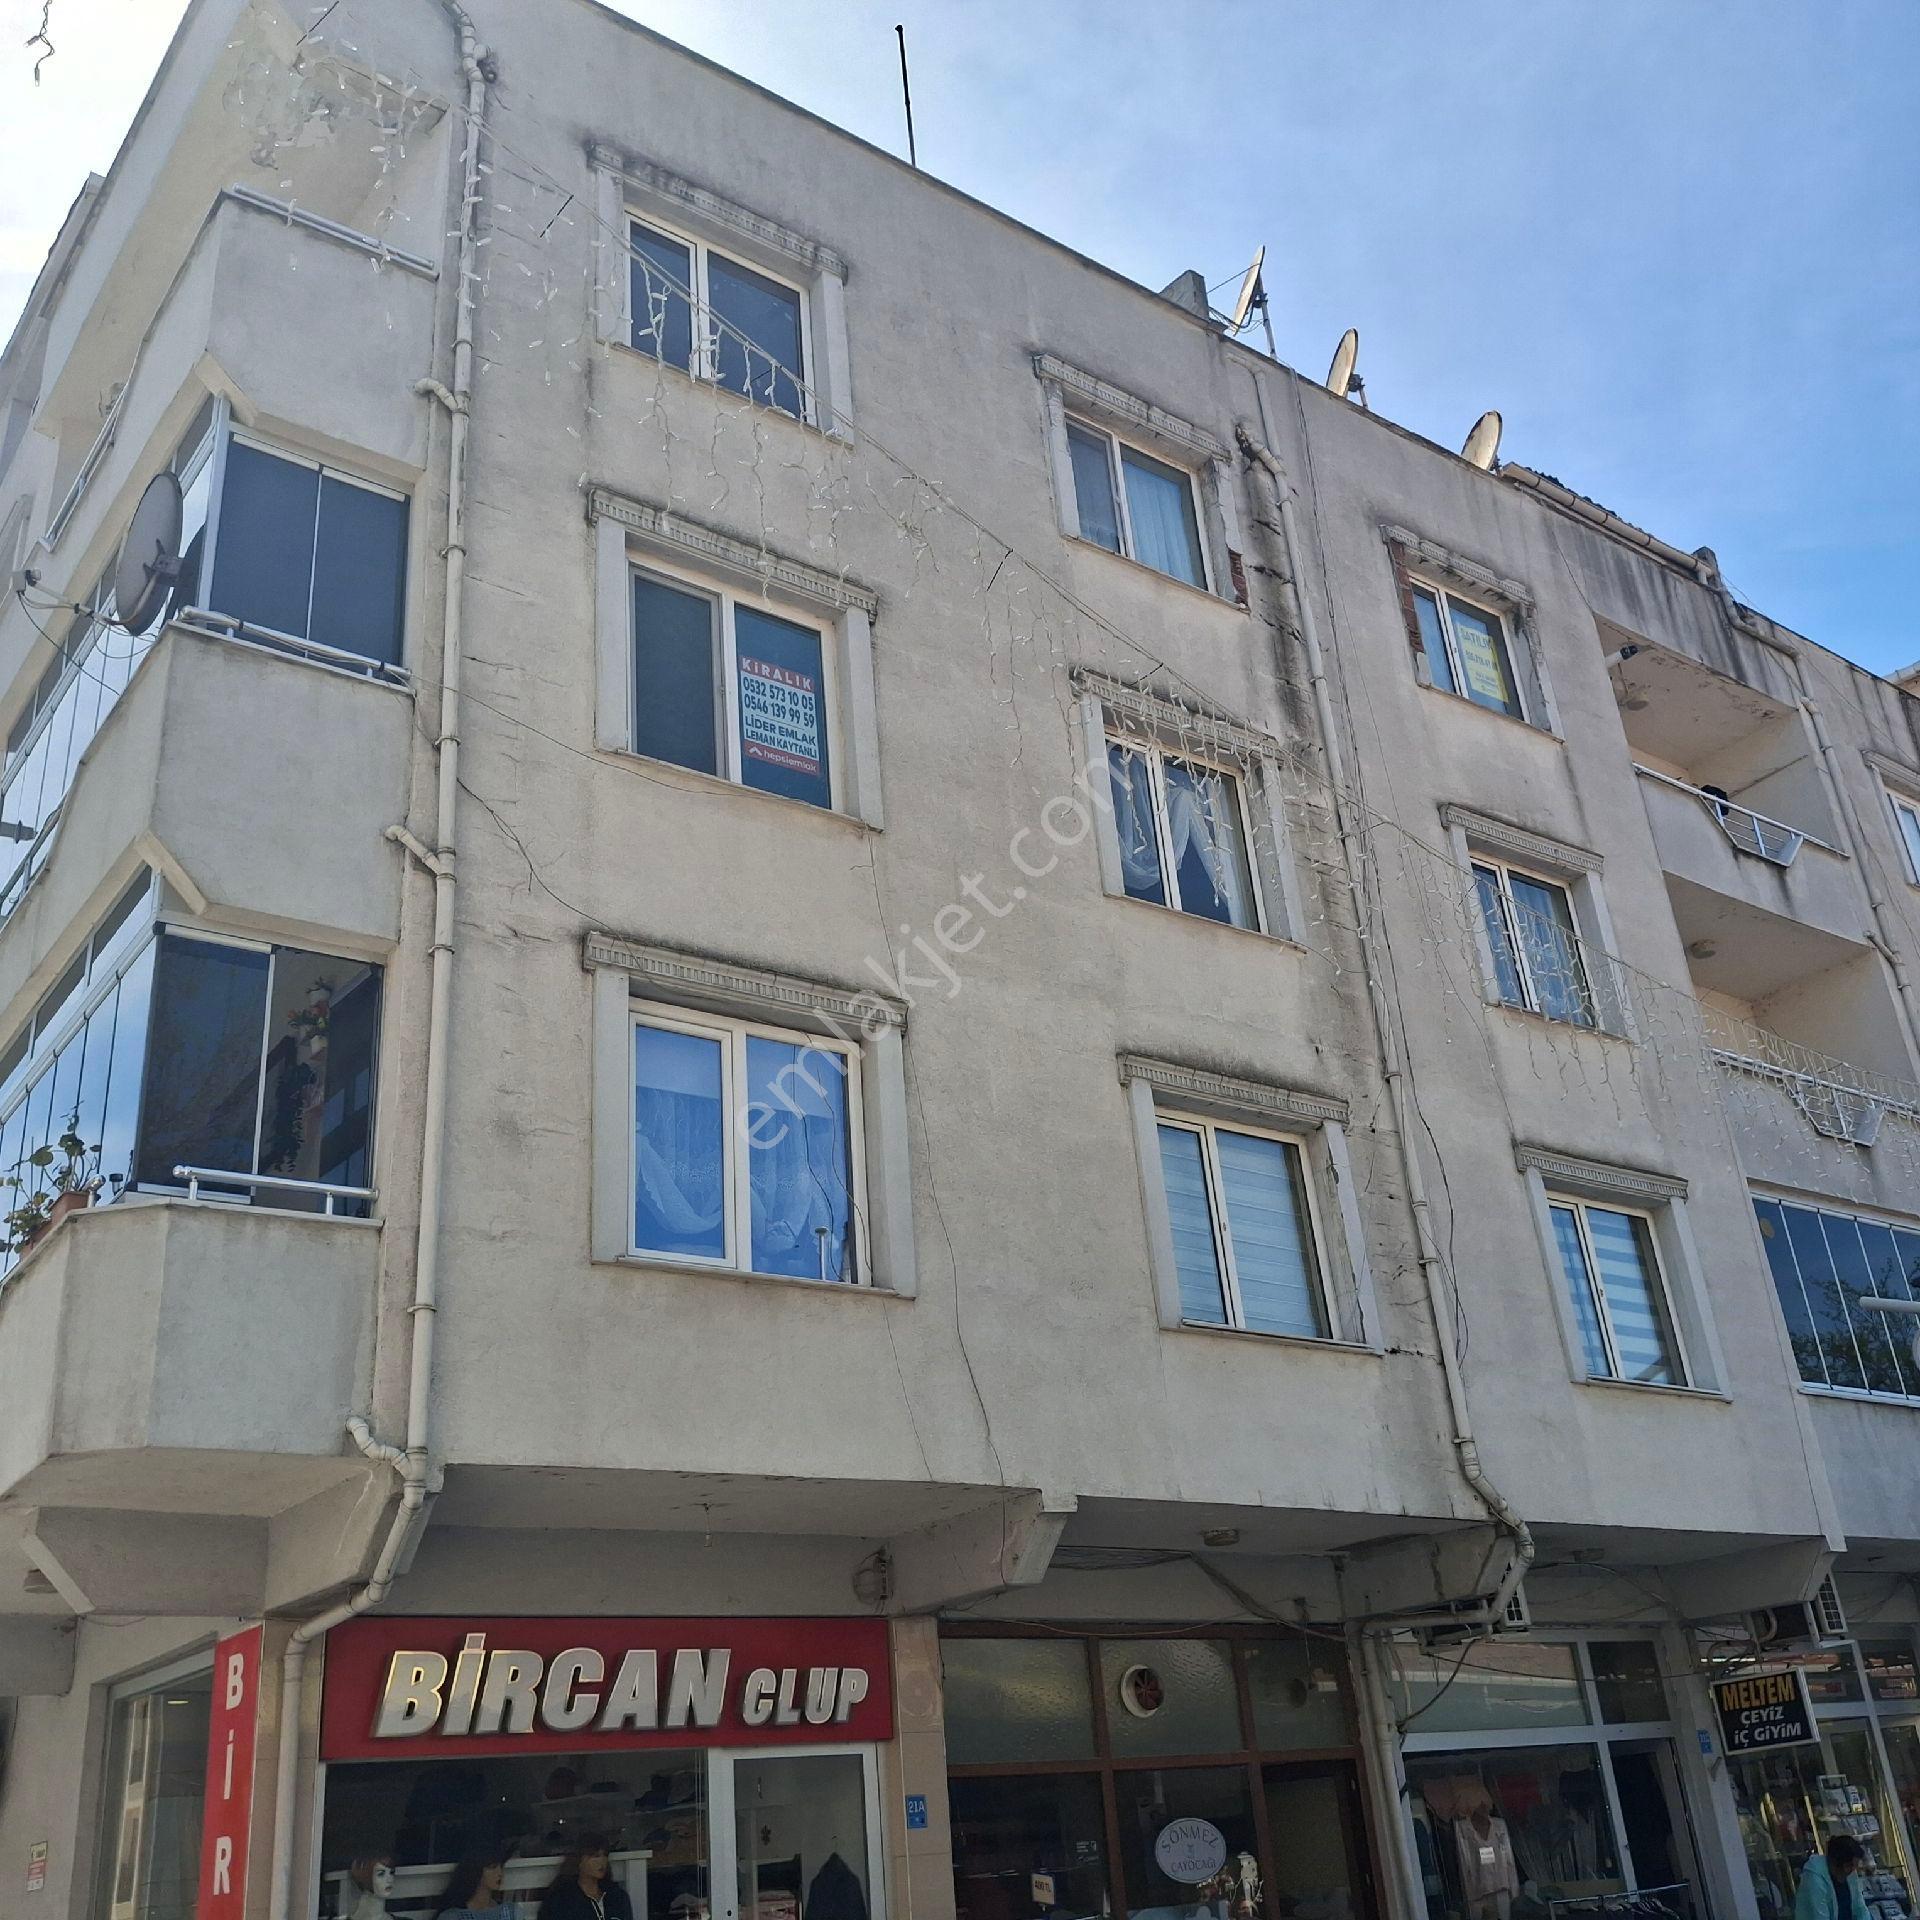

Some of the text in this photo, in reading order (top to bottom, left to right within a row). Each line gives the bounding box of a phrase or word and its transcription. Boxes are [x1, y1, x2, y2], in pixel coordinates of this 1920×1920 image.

[743, 677, 814, 712] 0532 573 10 05
[744, 694, 815, 728] 0546 139 99 59
[745, 728, 775, 746] LEMAN
[778, 726, 816, 746] EMLAK
[764, 750, 817, 772] hepsiemlak
[374, 1633, 869, 1738] BİRCAN CLUP
[1722, 1674, 1796, 1711] MELTEM
[908, 1800, 925, 1813] 21A
